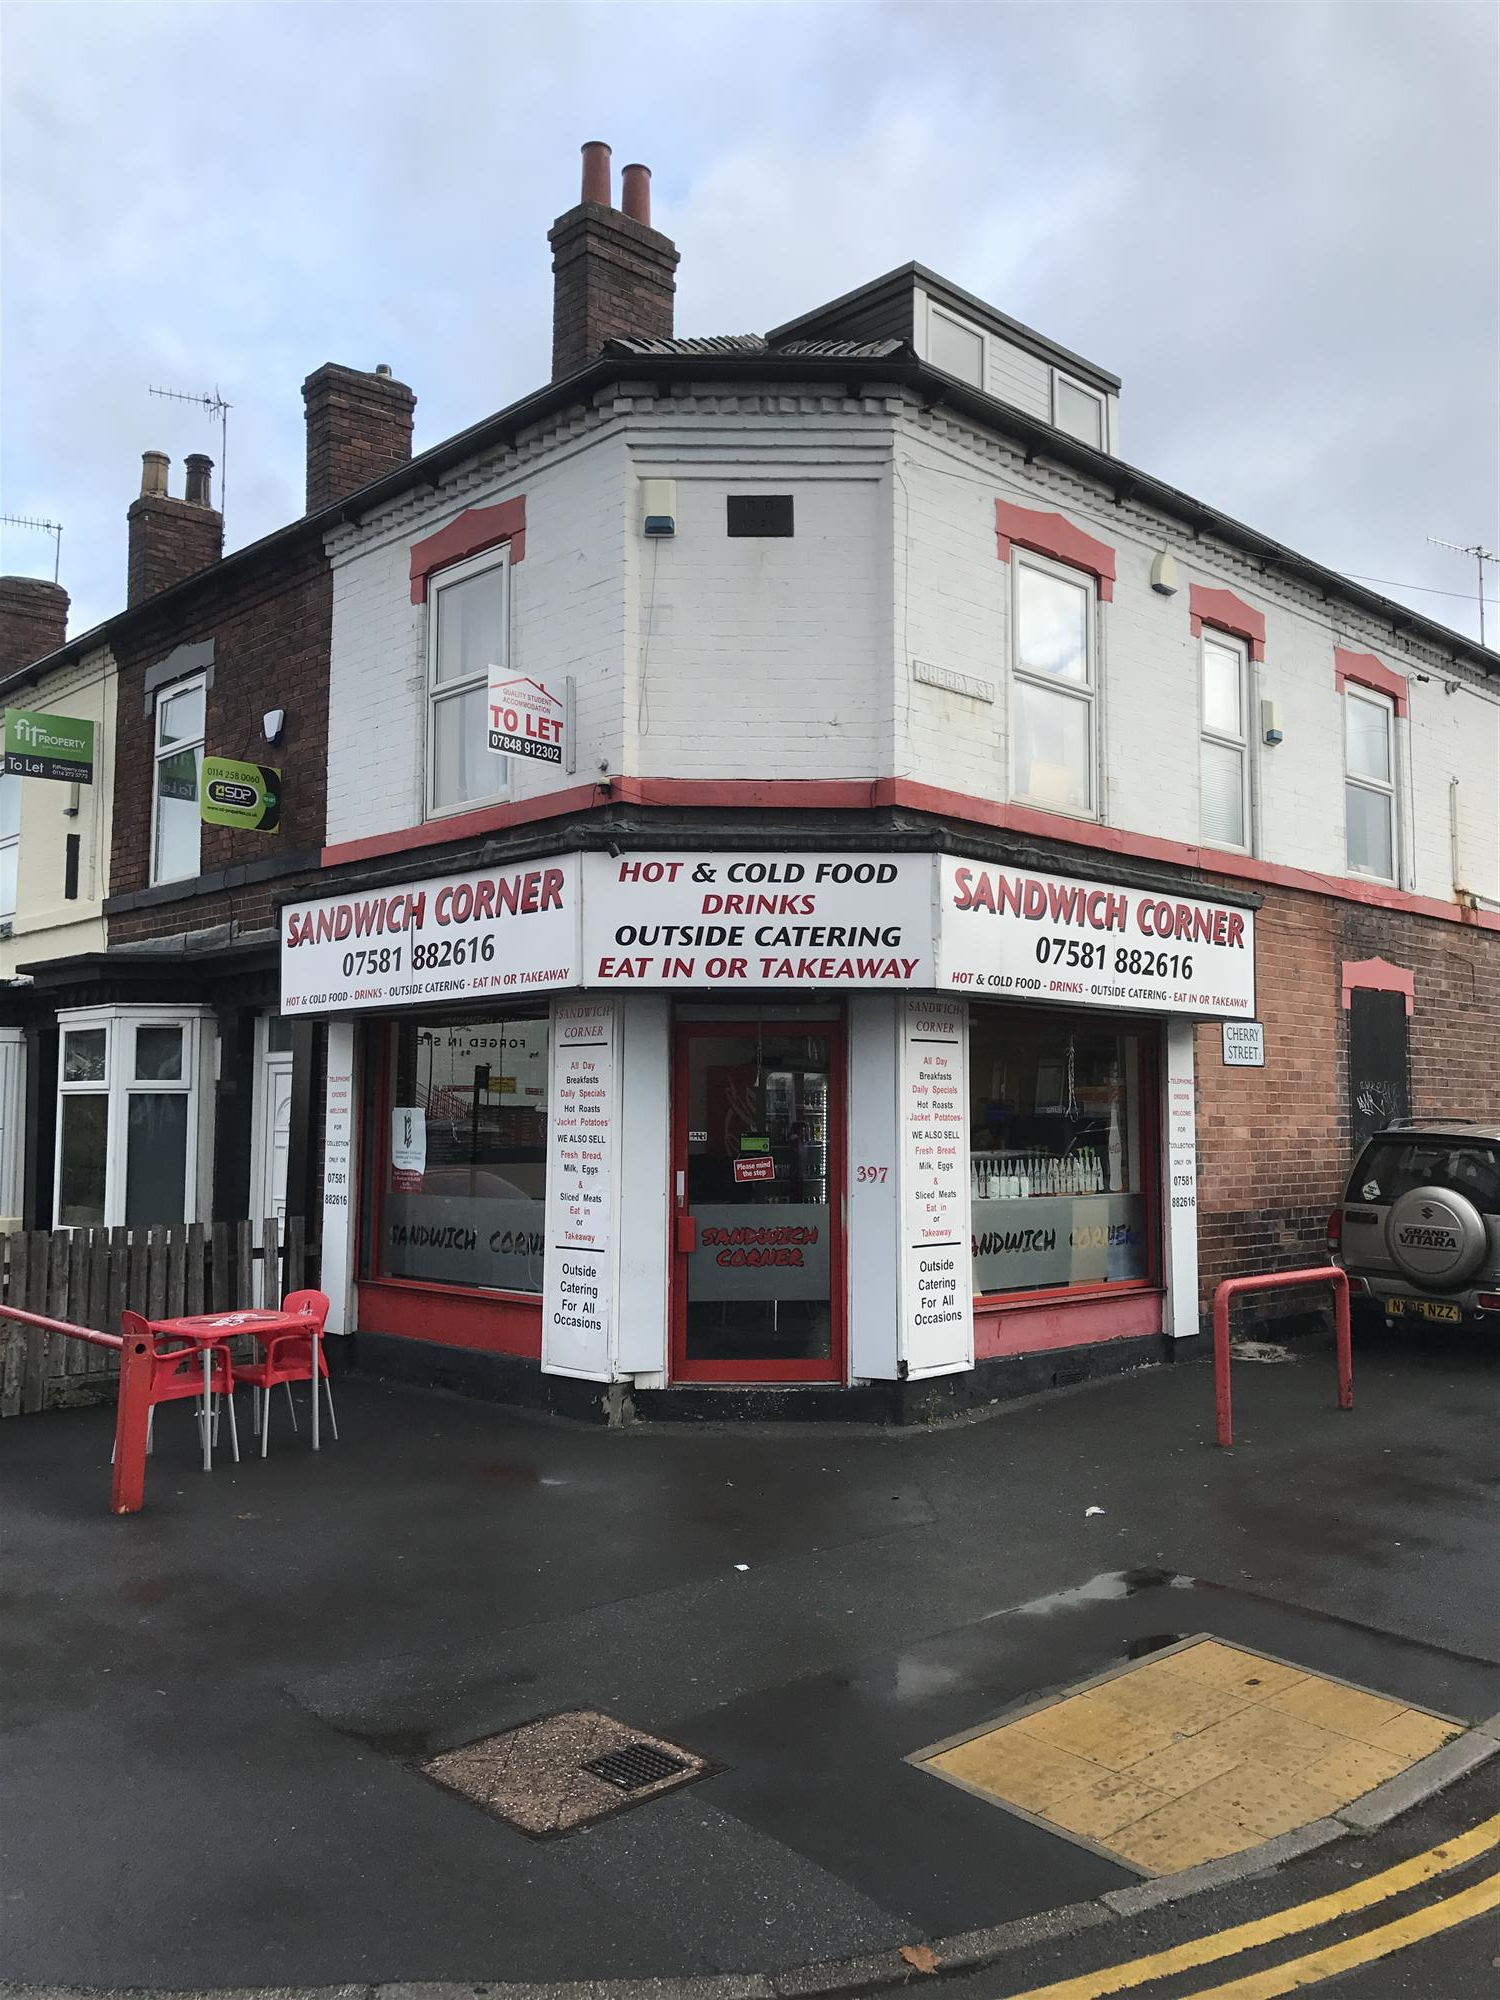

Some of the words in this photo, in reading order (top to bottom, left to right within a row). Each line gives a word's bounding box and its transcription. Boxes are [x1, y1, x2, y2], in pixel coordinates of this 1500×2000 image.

[502, 688, 527, 699] QUALITY
[527, 694, 552, 706] STUDENT
[502, 697, 551, 714] ACCOMMODATION
[490, 704, 518, 732] TO
[526, 713, 564, 743] LET
[38, 735, 86, 749] PROPERTY
[491, 734, 522, 753] 07848
[524, 742, 560, 761] 912302
[8, 757, 23, 771] To
[26, 759, 44, 773] Let
[207, 767, 224, 778] 0114
[225, 770, 240, 780] 258
[241, 774, 260, 784] 0060
[618, 861, 684, 883] HOT
[691, 862, 717, 883] &
[727, 862, 805, 884] COLD
[814, 863, 898, 884] FOOD
[286, 891, 427, 949] SANDWICH
[435, 868, 565, 927] CORNER
[701, 894, 816, 915] DRINKS
[953, 867, 1127, 933] SANDWICH
[1136, 898, 1245, 949] CORNER
[614, 925, 745, 947] OUTSIDE
[754, 926, 902, 947] CATERING
[342, 946, 402, 977] 07581
[412, 934, 495, 971] 882616
[1035, 936, 1107, 971] 07581
[1114, 948, 1193, 980] 882616
[597, 957, 654, 978] EAT
[661, 958, 695, 978] IN
[704, 957, 748, 978] OR
[759, 958, 920, 980] TAKEAWAY
[286, 996, 300, 1007] HOT
[301, 996, 308, 1005] &
[309, 994, 327, 1004] COLD
[328, 991, 348, 1003] FOOD
[354, 988, 382, 1000] DRINKS
[389, 983, 423, 997] OUTSIDE
[425, 979, 465, 993] CATERING
[473, 976, 489, 989] EAT
[491, 975, 501, 987] IN
[503, 973, 517, 985] OR
[520, 967, 571, 984] TAKEAWAY
[952, 971, 974, 985] HOT
[975, 973, 985, 986] &
[987, 974, 1013, 987] COLD
[1015, 977, 1041, 990] FOOD
[1049, 980, 1083, 993] DRINKS
[1090, 984, 1126, 998] OUTSIDE
[1128, 988, 1167, 1001] CATERING
[1173, 992, 1188, 1002] EAT
[1189, 994, 1197, 1004] IN
[1199, 995, 1210, 1005] OR
[1211, 996, 1249, 1009] TAKEAWAY
[558, 1006, 611, 1020] SANDWICH
[909, 1000, 960, 1016] SANDWICH
[564, 1025, 604, 1039] CORNER
[916, 1020, 955, 1034] CORNER
[1226, 1026, 1260, 1041] CHERRY
[1228, 1045, 1259, 1060] STREET
[571, 1061, 579, 1070] All
[583, 1061, 596, 1072] Day
[923, 1056, 933, 1066] All
[935, 1057, 948, 1067] Day
[329, 1075, 350, 1083] TELEPHONE
[566, 1075, 599, 1086] Breakfasts
[919, 1071, 953, 1081] Breakfasts
[560, 1089, 576, 1100] Daily
[579, 1089, 606, 1100] Specials
[912, 1085, 929, 1095] Daily
[932, 1086, 958, 1096] Specials
[564, 1104, 575, 1113] Hot
[579, 1105, 601, 1114] Roasts
[917, 1100, 929, 1109] Hot
[932, 1101, 954, 1110] Roasts
[557, 1118, 577, 1127] Jacket
[580, 1118, 609, 1127] Potatoes
[909, 1113, 931, 1121] Jacket
[934, 1113, 960, 1122] Potatoes
[557, 1134, 569, 1144] WE
[569, 1134, 588, 1144] ALSO
[588, 1135, 606, 1144] SELL
[912, 1130, 923, 1140] WE
[924, 1130, 943, 1140] ALSO
[943, 1130, 960, 1140] SELL
[561, 1150, 579, 1159] Fresh
[915, 1146, 934, 1155] Fresh
[564, 1164, 579, 1174] Milk,
[582, 1165, 599, 1175] Eggs
[736, 1163, 756, 1171] Please
[919, 1161, 934, 1170] Milk,
[938, 1161, 954, 1171] Eggs
[327, 1173, 346, 1184] 07581
[856, 1166, 889, 1184] 397
[933, 1177, 939, 1186] &
[1173, 1175, 1193, 1186] 07581
[578, 1181, 584, 1190] &
[325, 1194, 347, 1206] 882616
[560, 1192, 580, 1202] Sliced
[583, 1193, 603, 1203] Meats
[915, 1191, 935, 1200] Sliced
[939, 1190, 957, 1199] Meats
[1172, 1196, 1196, 1208] 882616
[569, 1206, 581, 1215] Eat
[584, 1206, 591, 1216] in
[926, 1203, 937, 1213] Eat
[940, 1203, 947, 1212] in
[576, 1219, 584, 1227] or
[933, 1215, 940, 1223] or
[391, 1225, 477, 1251] SANDWICH
[564, 1231, 596, 1244] Takeaway
[701, 1225, 820, 1247] SANDWICH
[921, 1228, 952, 1238] Takeaway
[1404, 1227, 1450, 1238] GRAND
[1398, 1233, 1458, 1249] VITARA
[716, 1248, 805, 1267] CORNER
[562, 1263, 597, 1278] Outside
[919, 1259, 954, 1273] Outside
[560, 1280, 599, 1299] Catering
[918, 1277, 956, 1292] Catering
[562, 1299, 577, 1312] For
[582, 1301, 595, 1314] All
[921, 1296, 937, 1309] For
[942, 1294, 954, 1306] All
[914, 1310, 962, 1326] Occasions
[1427, 1303, 1454, 1319] NZZ
[553, 1312, 602, 1331] Occasions
